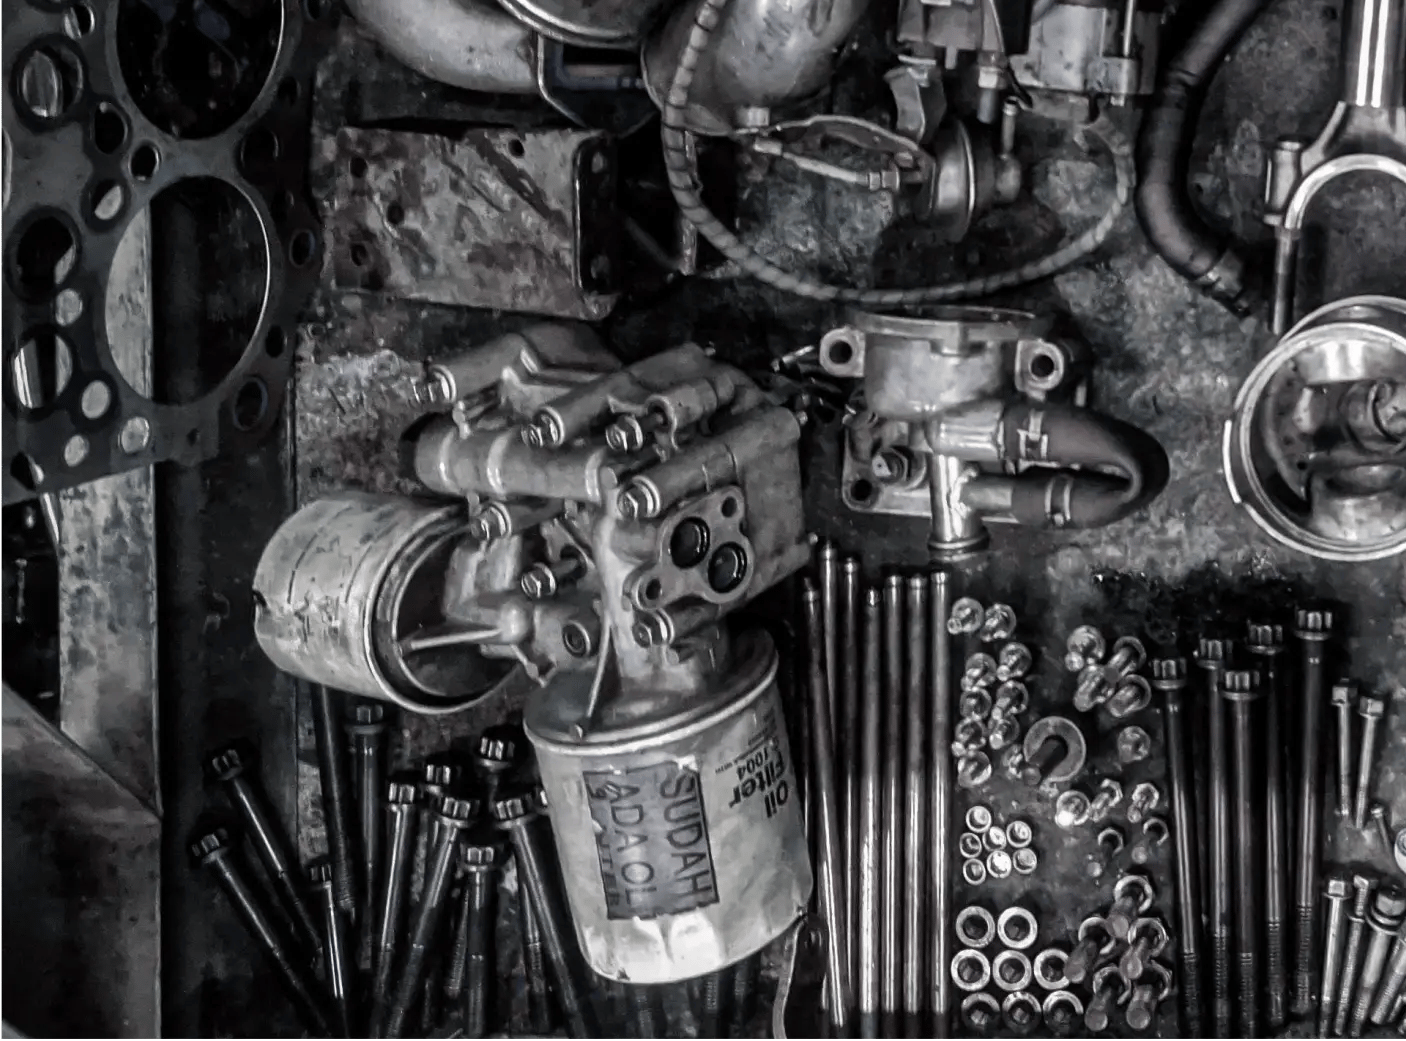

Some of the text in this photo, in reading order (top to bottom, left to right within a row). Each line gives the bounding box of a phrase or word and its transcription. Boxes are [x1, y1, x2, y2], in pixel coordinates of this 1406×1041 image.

[728, 749, 786, 809] Filter
[764, 779, 789, 819] Oil
[608, 785, 648, 853] ADA
[660, 770, 713, 897] SUDAH
